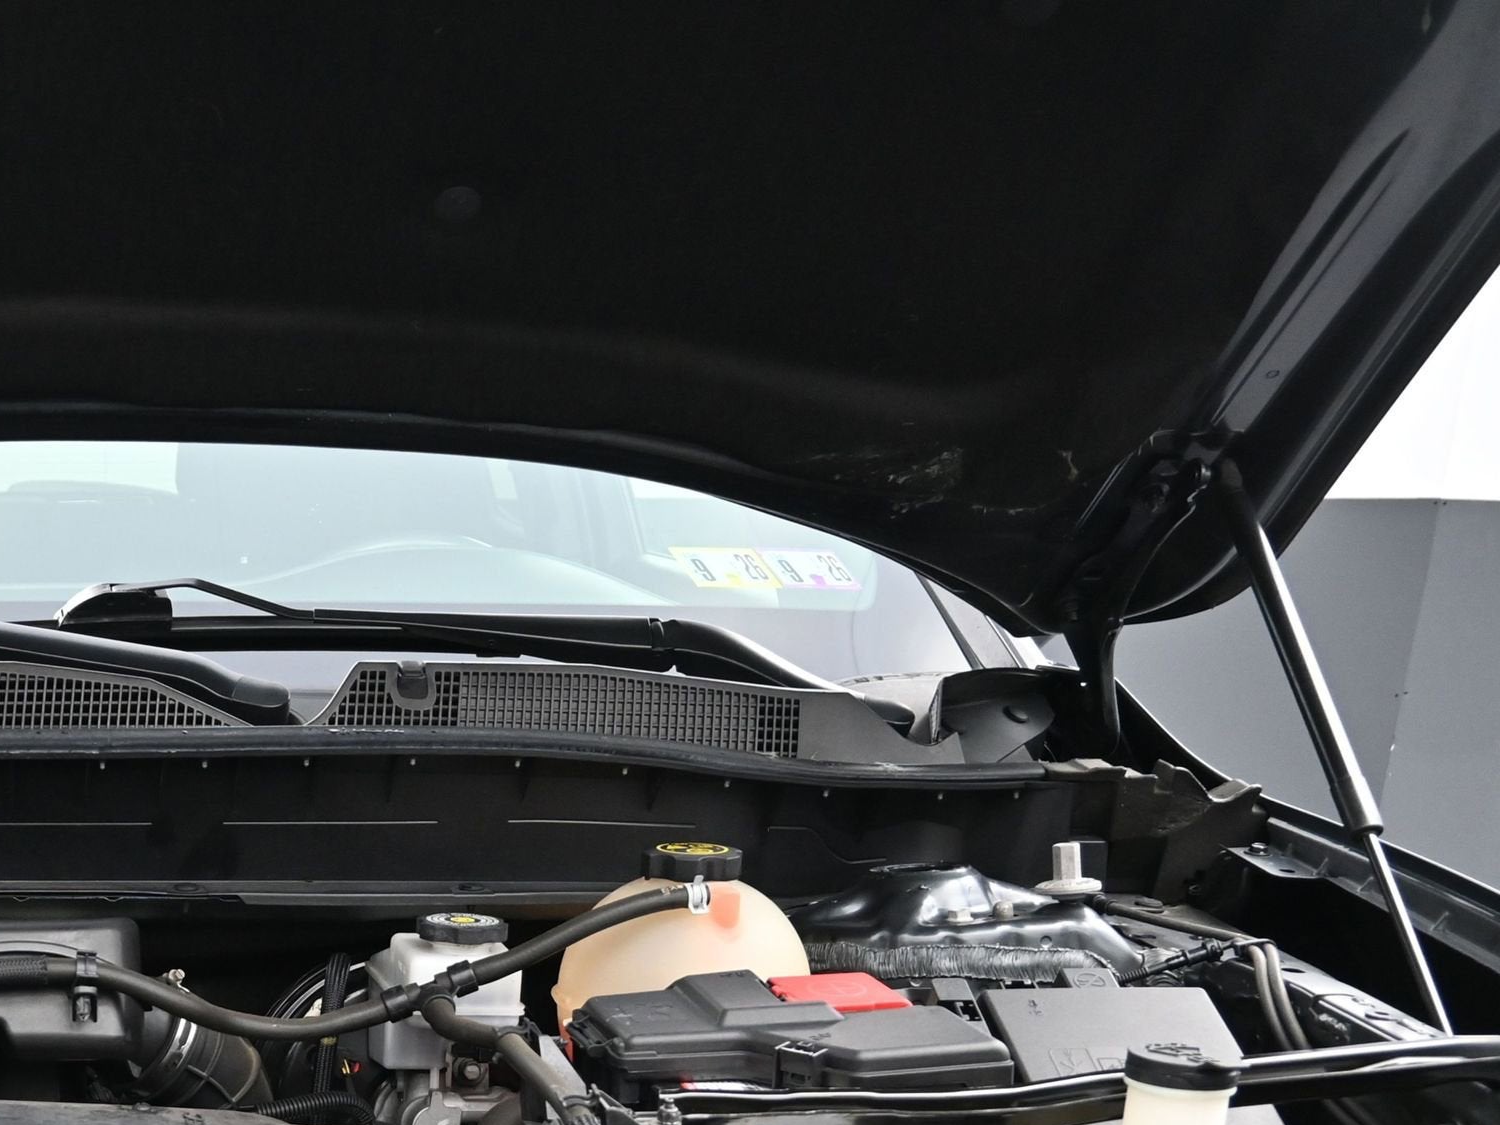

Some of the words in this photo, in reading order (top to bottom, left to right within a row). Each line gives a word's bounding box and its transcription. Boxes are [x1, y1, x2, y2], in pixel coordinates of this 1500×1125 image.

[691, 558, 716, 581] 9
[734, 554, 769, 580] 26
[778, 559, 804, 582] 9
[817, 555, 852, 581] 26
